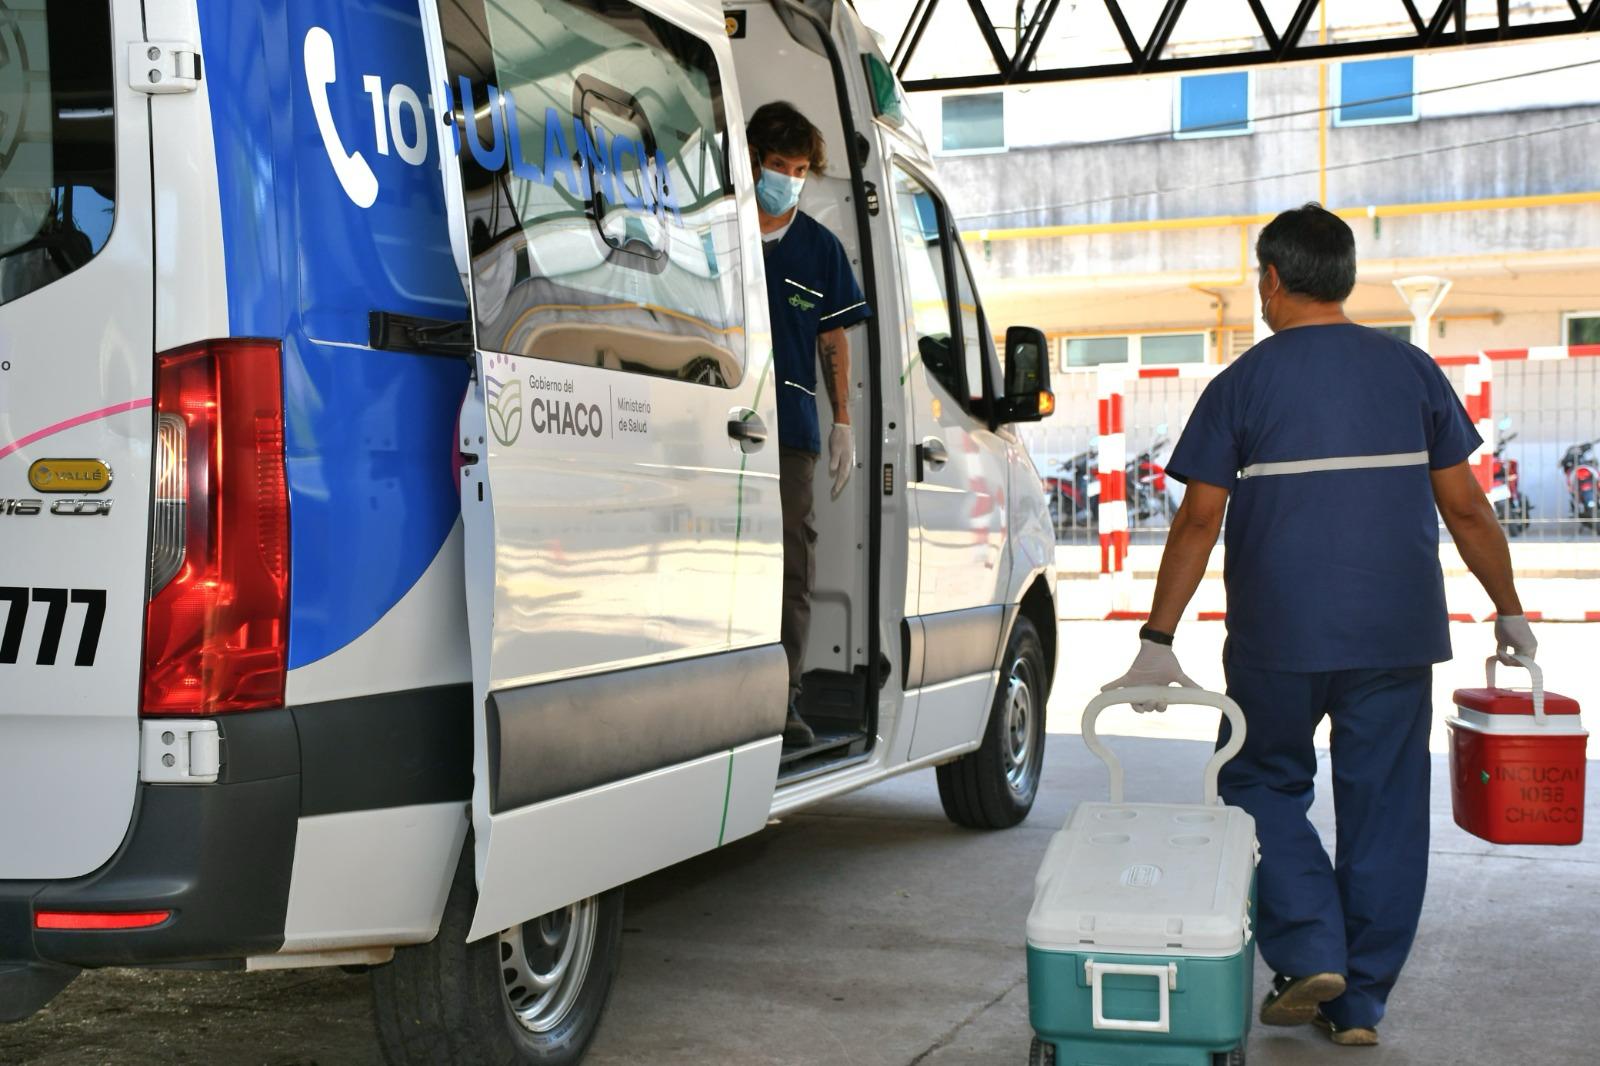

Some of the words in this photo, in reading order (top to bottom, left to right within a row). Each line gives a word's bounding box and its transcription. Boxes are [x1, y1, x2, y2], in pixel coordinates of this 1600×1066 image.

[362, 74, 441, 170] 10
[529, 374, 562, 392] Gobierno
[563, 379, 574, 393] del
[617, 397, 651, 414] Ministerio
[530, 398, 603, 438] CHACO
[618, 419, 627, 433] de
[628, 418, 647, 433] Salud
[1494, 766, 1580, 784] INCUCAI
[1505, 806, 1579, 823] CHACO
